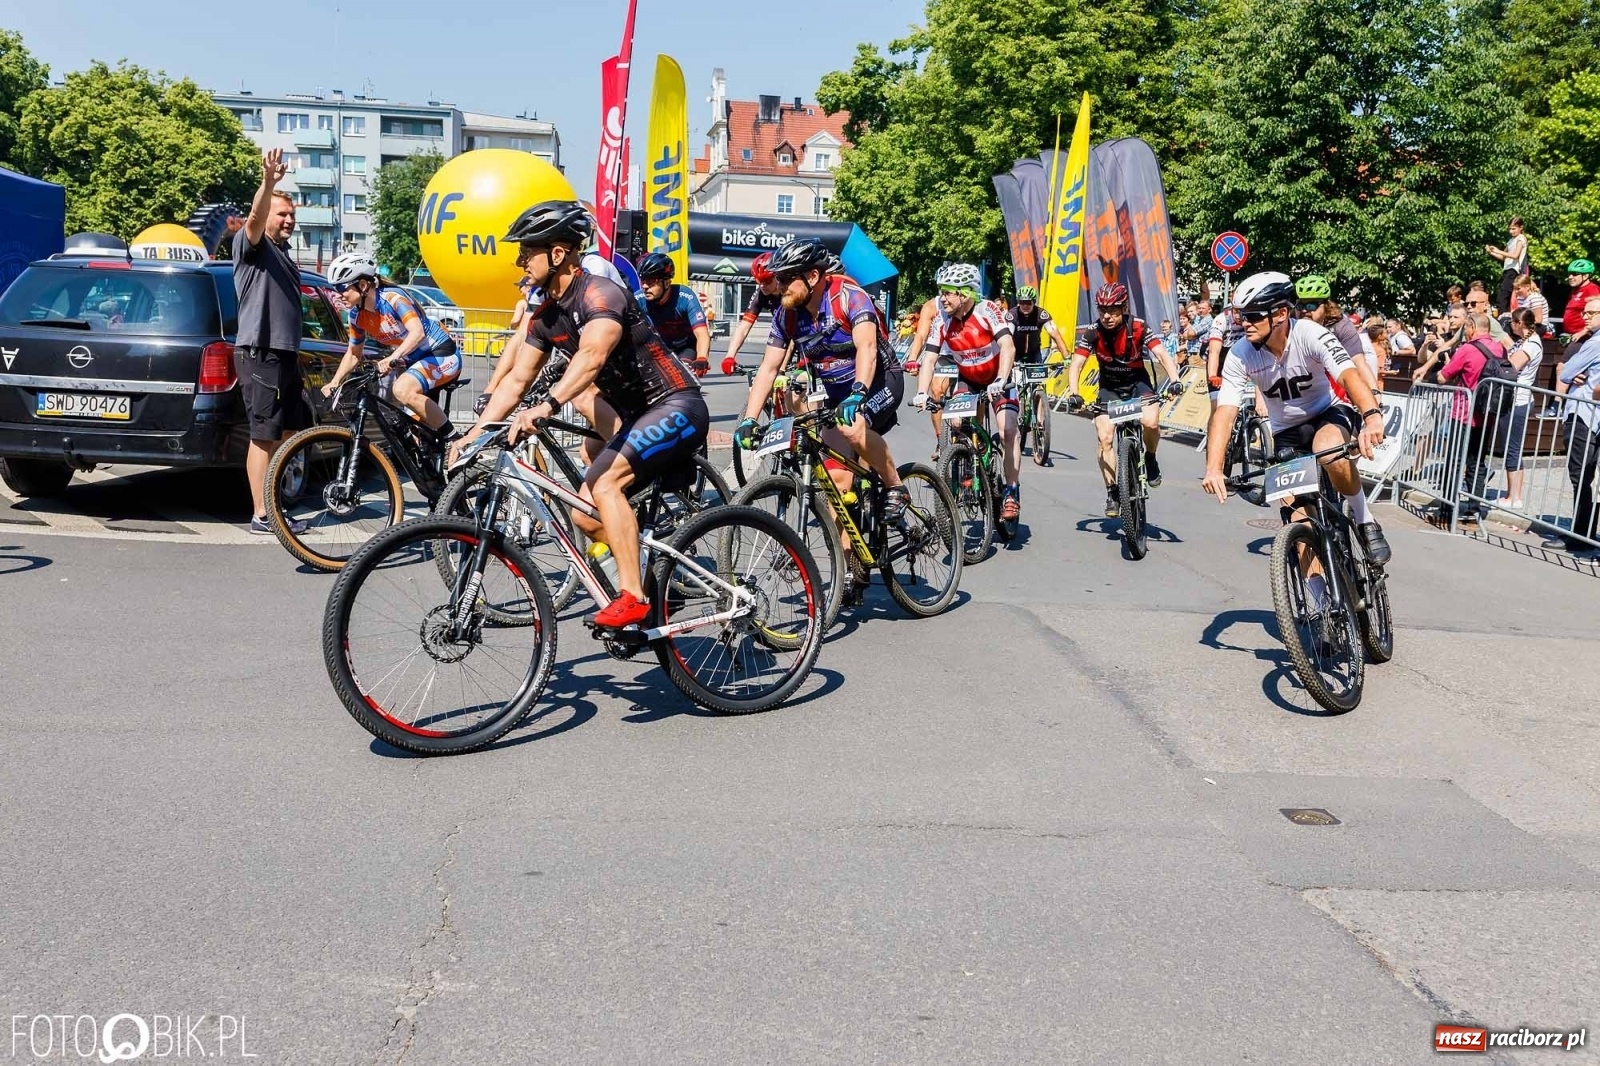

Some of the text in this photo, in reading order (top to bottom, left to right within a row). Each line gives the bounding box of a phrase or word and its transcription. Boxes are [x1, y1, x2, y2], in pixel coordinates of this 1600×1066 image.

[418, 192, 464, 236] MF
[456, 234, 497, 256] FM
[721, 228, 796, 248] bike ateli
[1318, 331, 1351, 366] TEAM
[46, 394, 128, 413] SWD 90476
[949, 401, 971, 410] 2228
[1115, 403, 1135, 415] 1744
[626, 410, 690, 453] Roca
[761, 429, 784, 446] 2156
[1274, 469, 1307, 488] 1677
[540, 641, 551, 670] COMP
